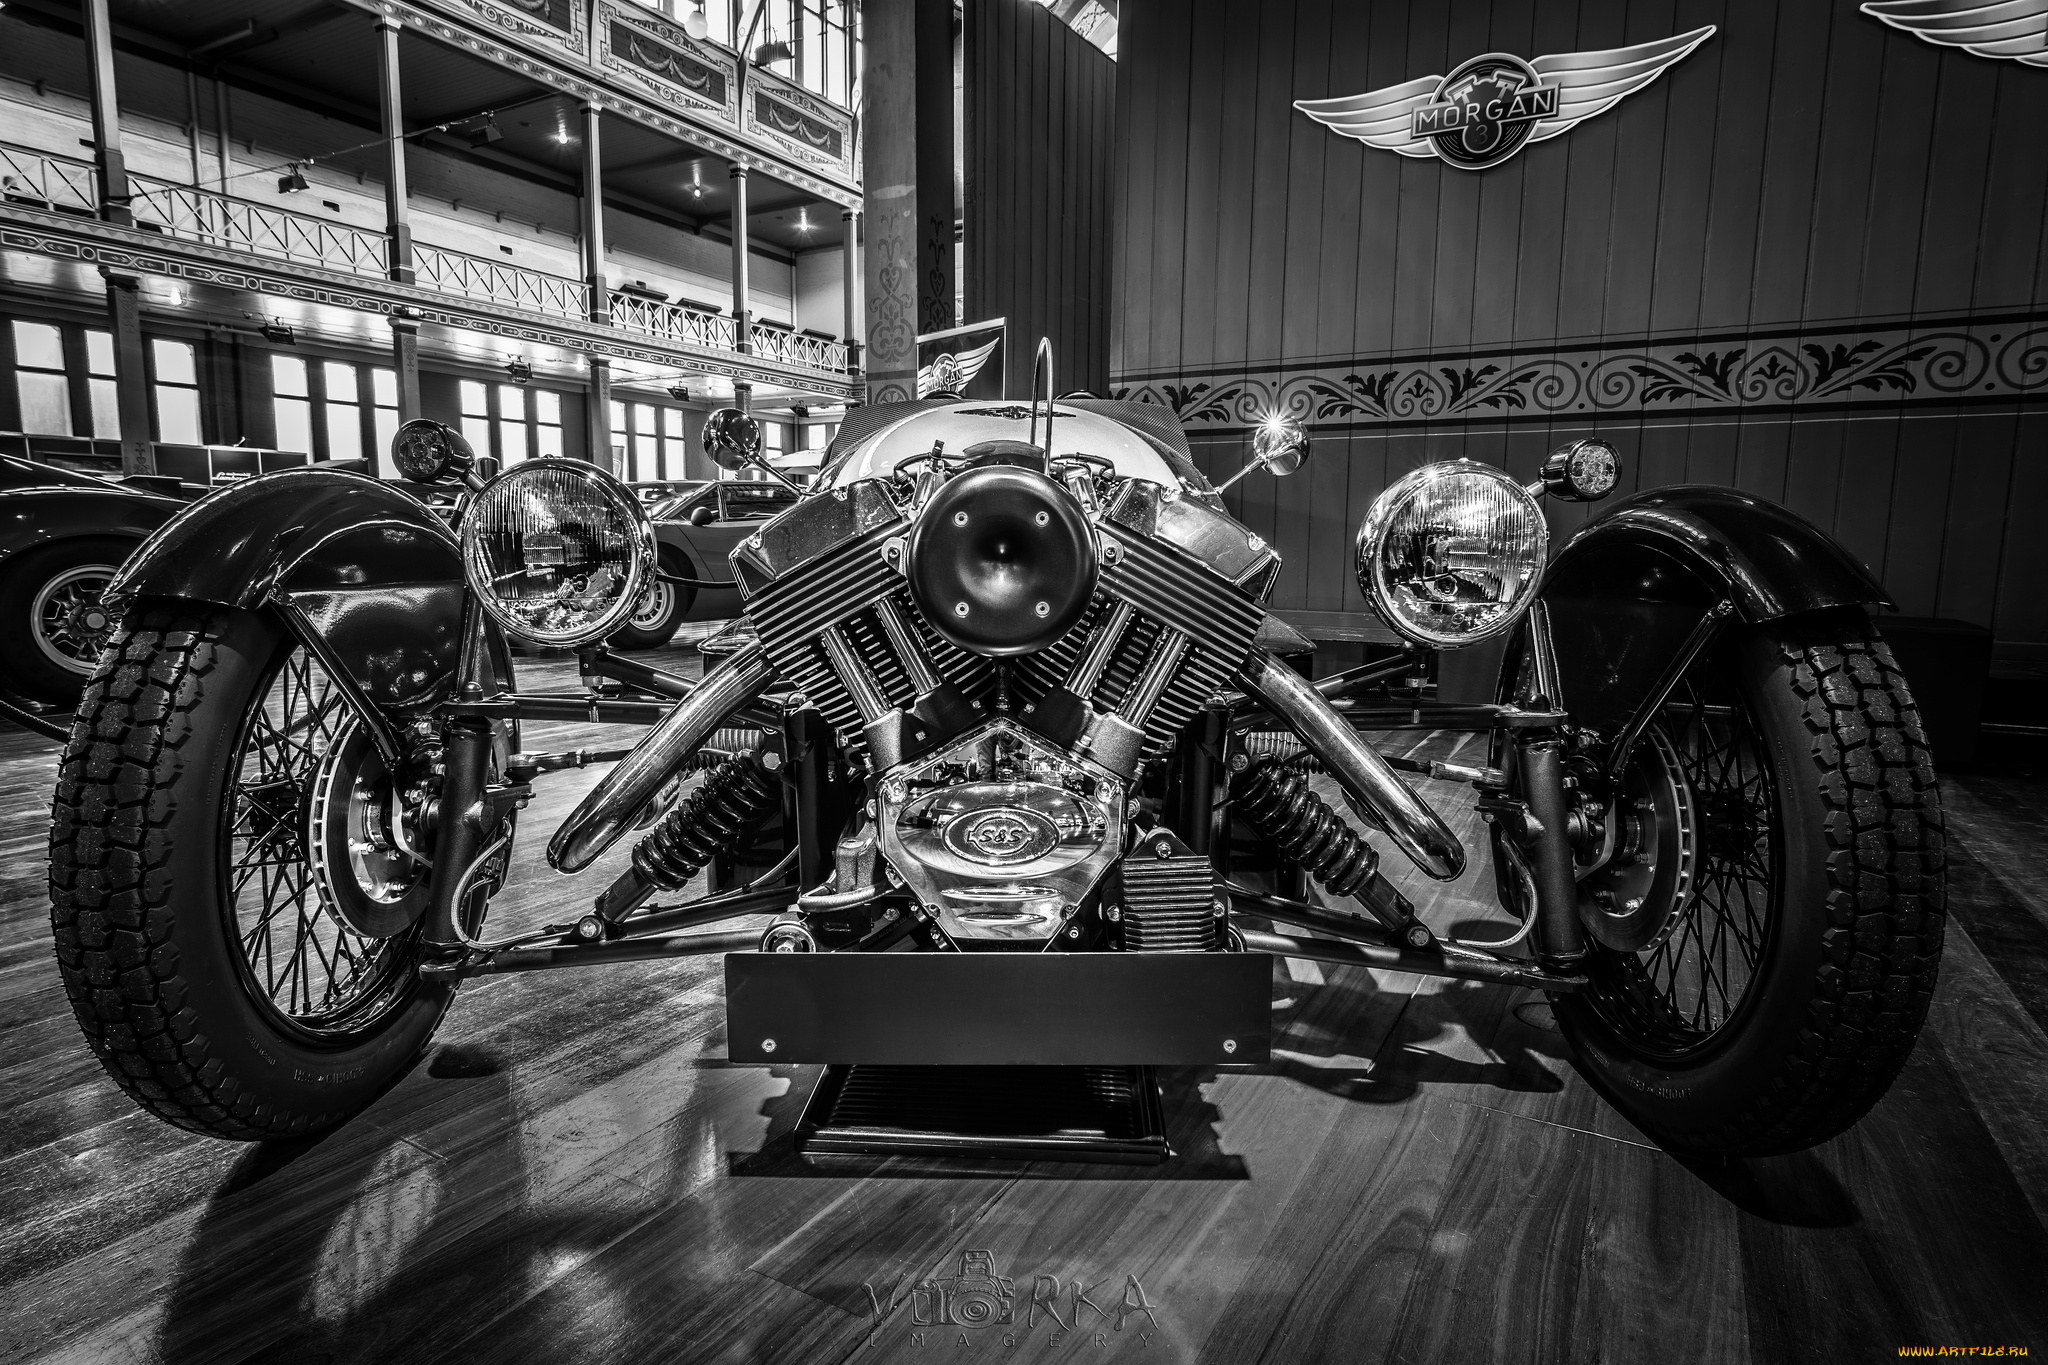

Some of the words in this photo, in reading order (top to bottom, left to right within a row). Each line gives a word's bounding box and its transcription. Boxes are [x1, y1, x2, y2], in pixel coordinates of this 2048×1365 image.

[1417, 90, 1552, 132] MORGAN
[926, 369, 962, 391] MORGAN
[979, 829, 1023, 843] S&S
